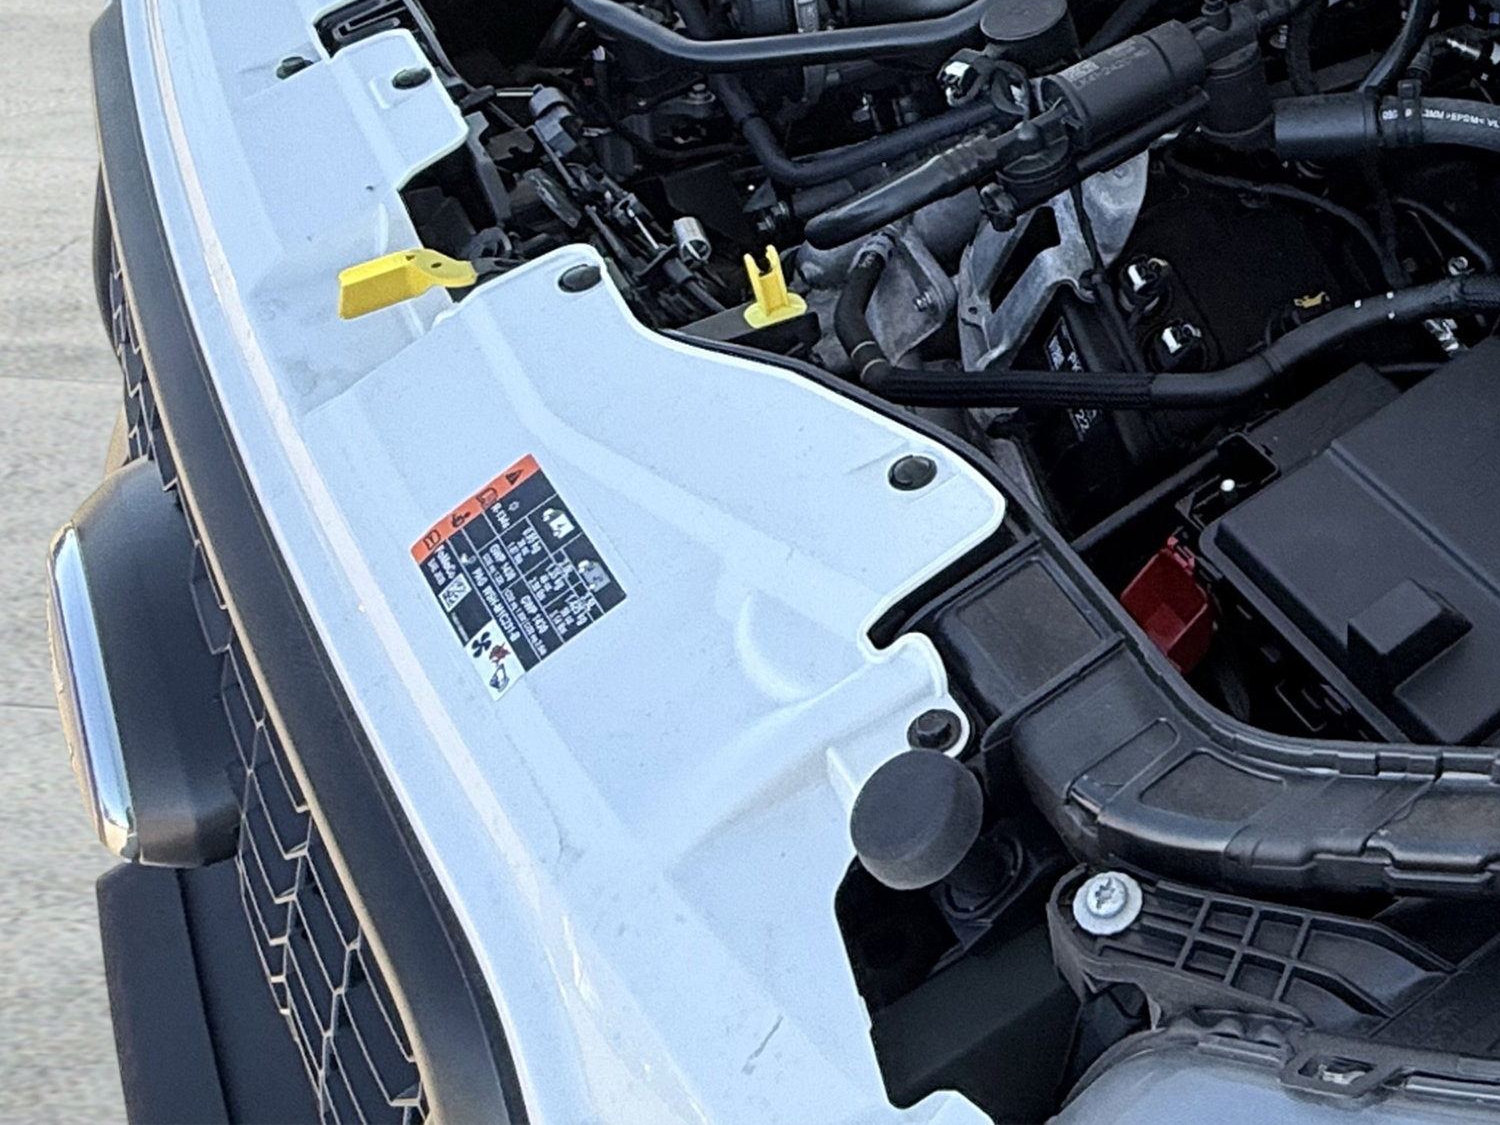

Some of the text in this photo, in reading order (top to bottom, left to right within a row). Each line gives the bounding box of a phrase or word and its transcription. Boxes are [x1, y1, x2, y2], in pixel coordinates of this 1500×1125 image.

[491, 502, 510, 529] R-134a
[432, 544, 456, 579] FoMoCo
[489, 543, 506, 562] GWP
[472, 567, 488, 586] PAG
[520, 594, 538, 613] GWP
